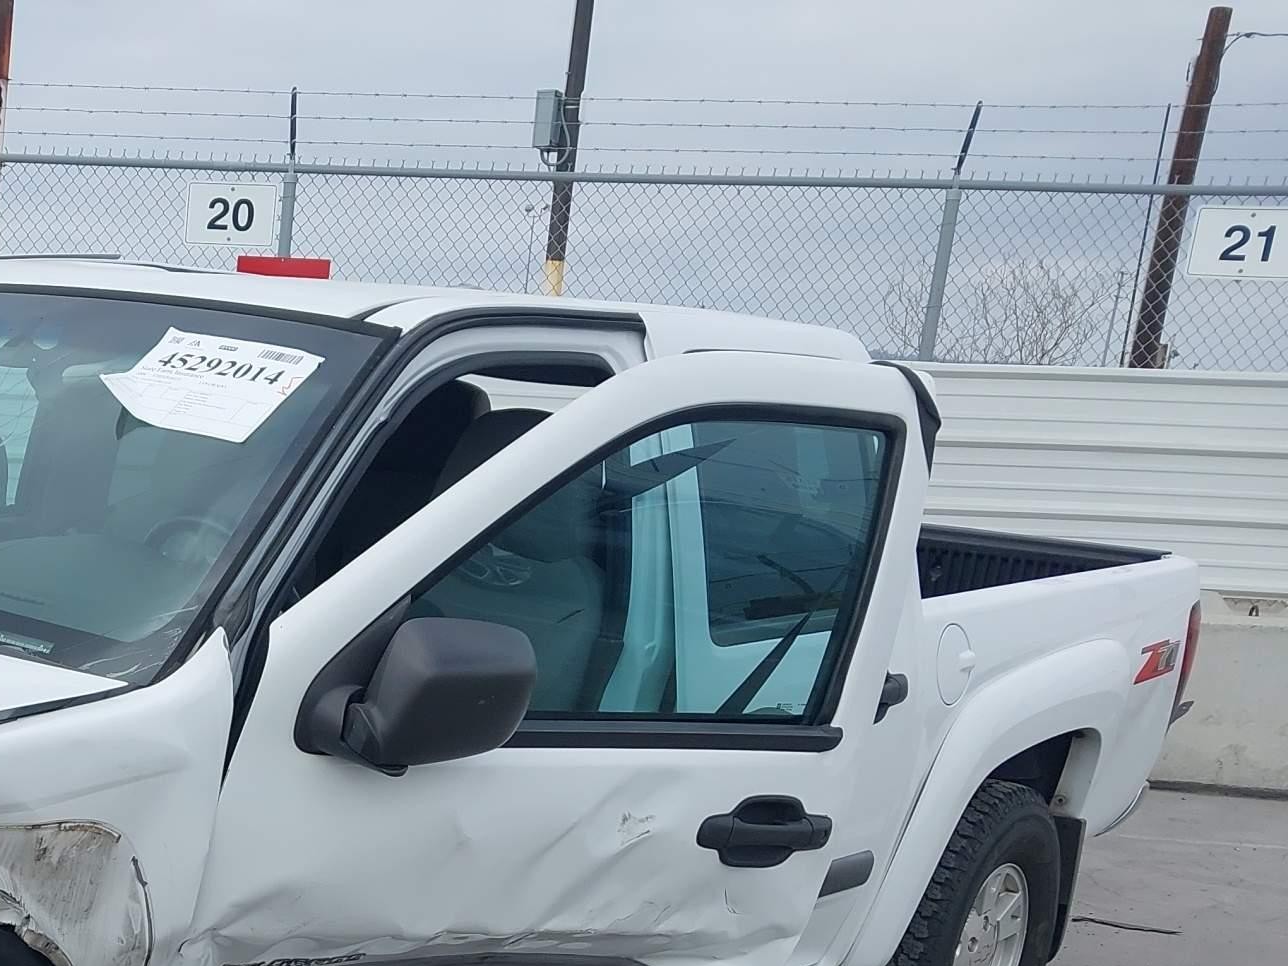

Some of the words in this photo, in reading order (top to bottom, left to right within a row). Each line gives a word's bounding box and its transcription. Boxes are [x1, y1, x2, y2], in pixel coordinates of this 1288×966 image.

[206, 197, 255, 232] 20
[1218, 224, 1277, 262] 21
[158, 352, 286, 385] 45292014
